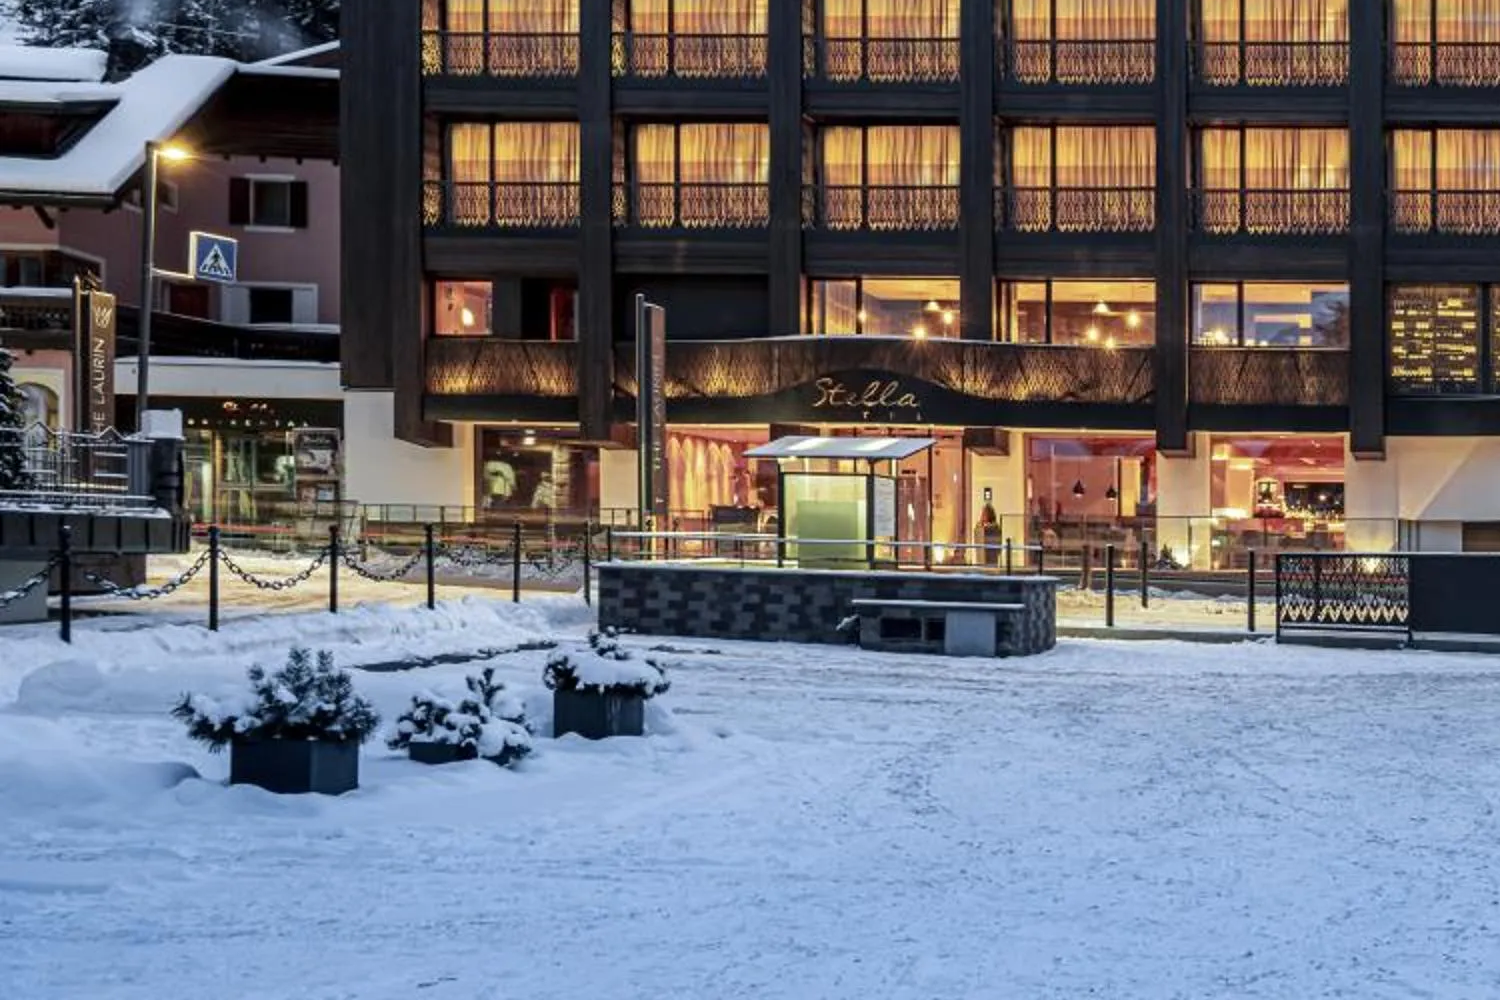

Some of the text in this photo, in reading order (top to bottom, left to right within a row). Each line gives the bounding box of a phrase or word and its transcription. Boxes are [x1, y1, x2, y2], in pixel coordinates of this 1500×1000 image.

[92, 337, 106, 437] HE LAURIN
[812, 377, 919, 407] Stella
